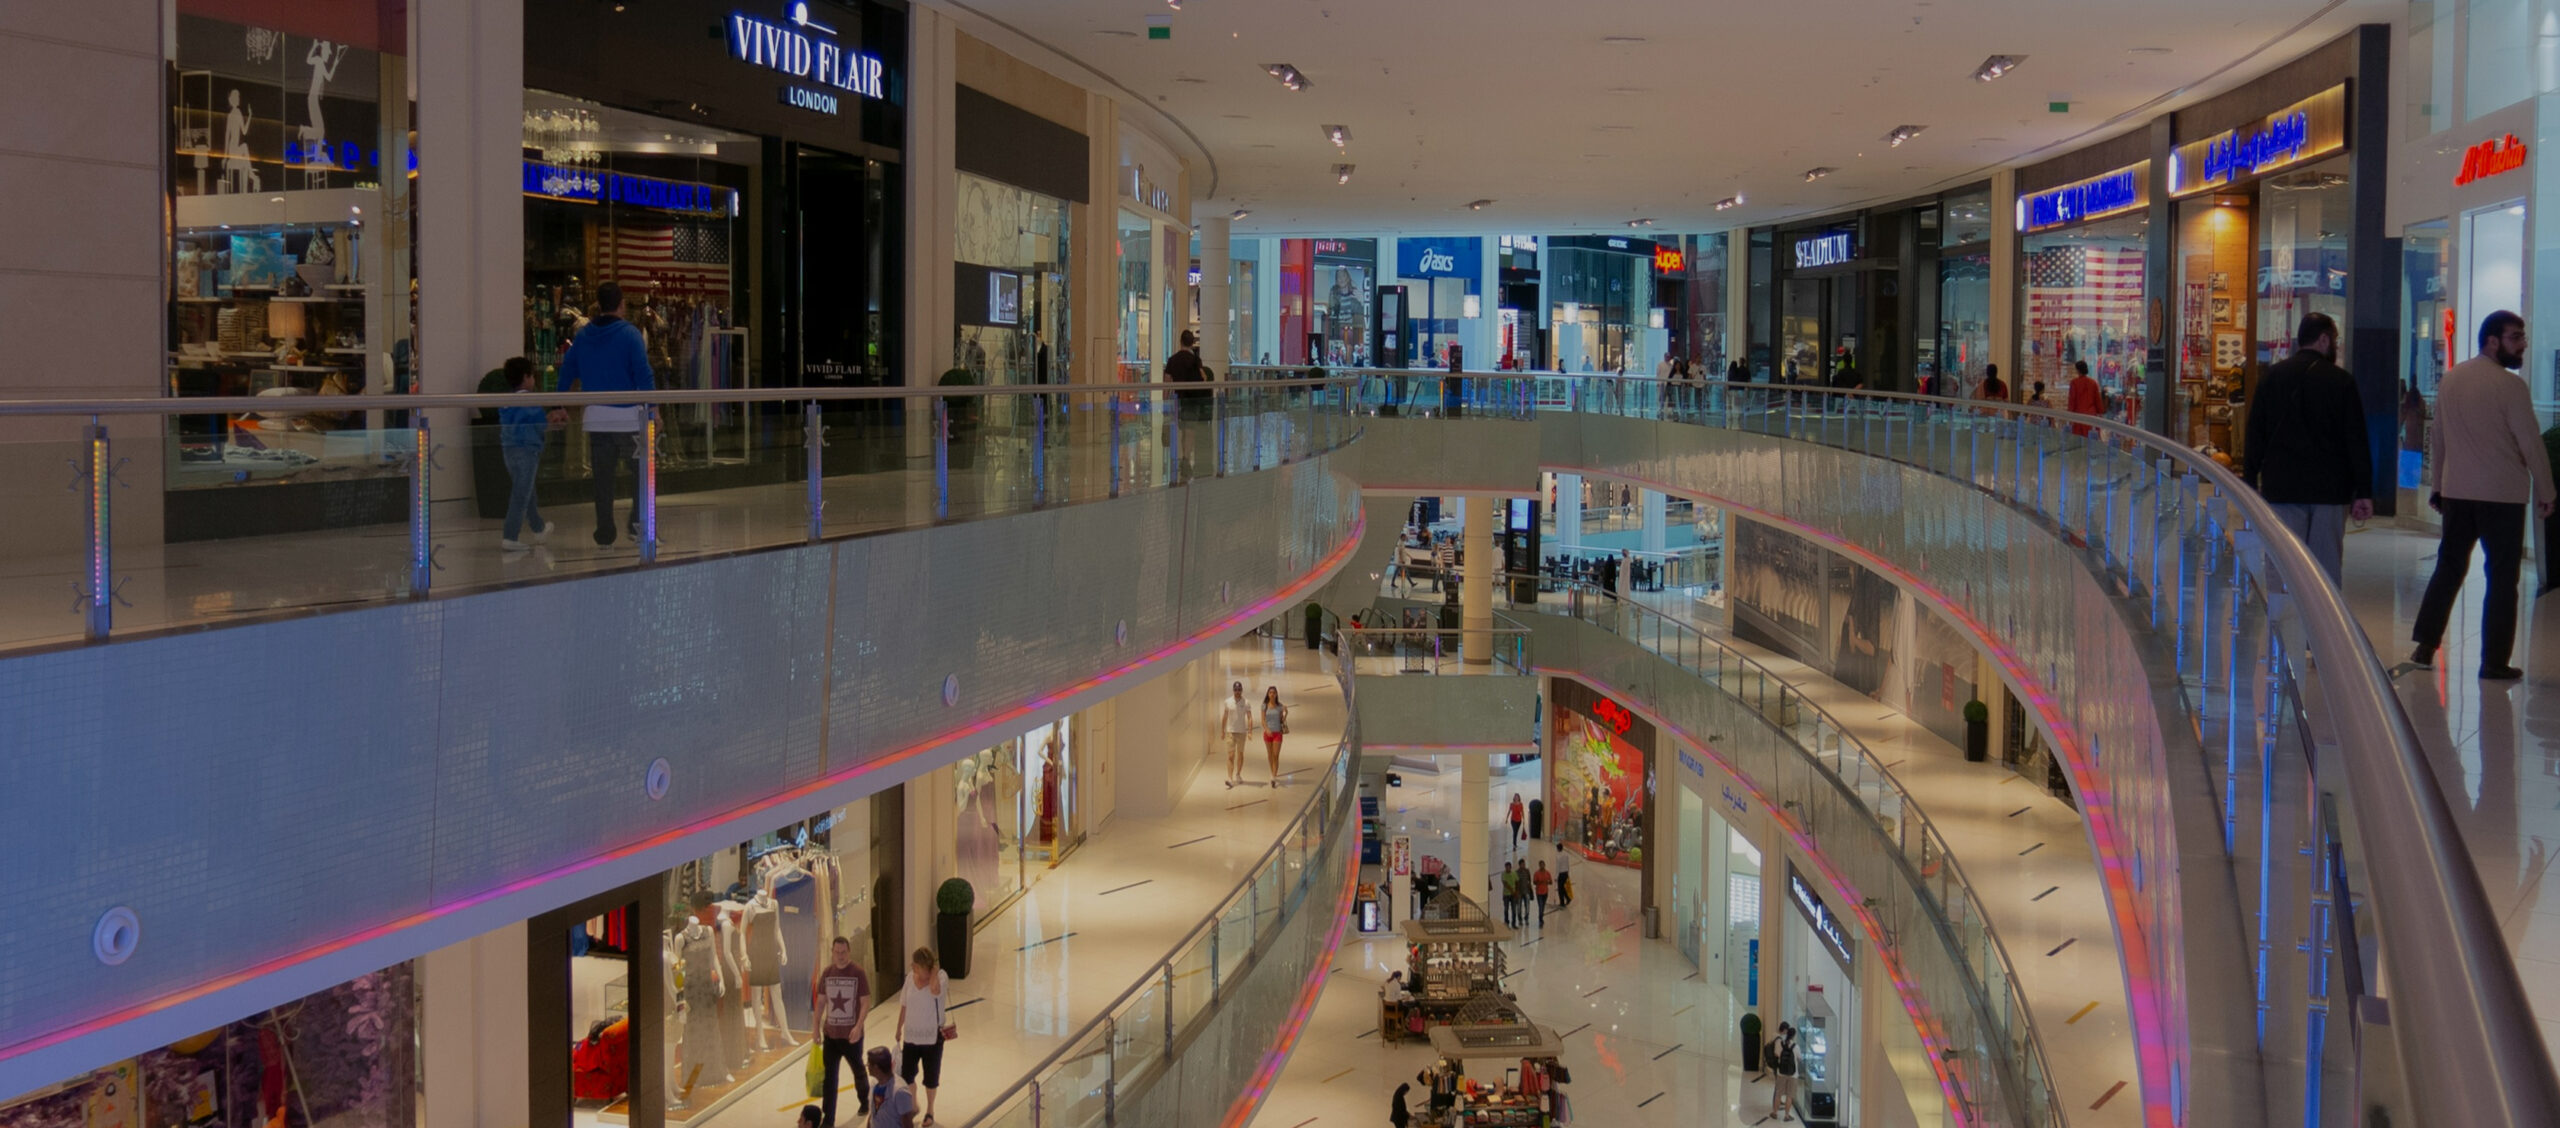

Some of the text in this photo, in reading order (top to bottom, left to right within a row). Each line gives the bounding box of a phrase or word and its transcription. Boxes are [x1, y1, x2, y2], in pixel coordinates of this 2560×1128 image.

[734, 15, 883, 99] VIVID FLAIR
[789, 86, 837, 116] LONDON
[1795, 233, 1848, 268] STADIUM
[806, 363, 862, 376] VIVID FLAIR
